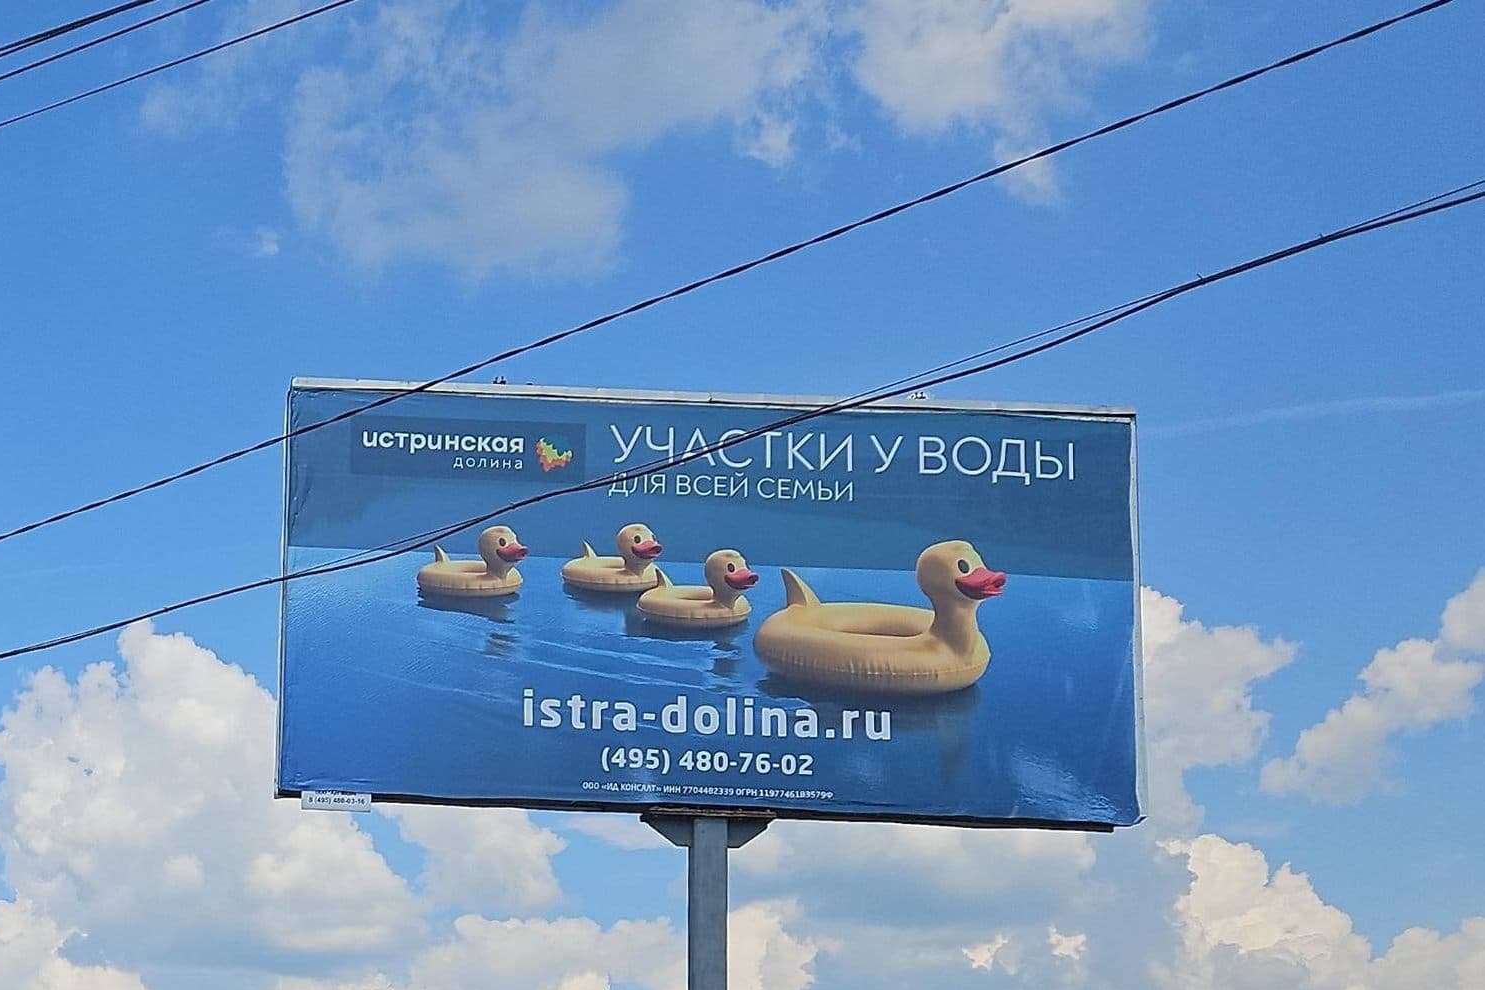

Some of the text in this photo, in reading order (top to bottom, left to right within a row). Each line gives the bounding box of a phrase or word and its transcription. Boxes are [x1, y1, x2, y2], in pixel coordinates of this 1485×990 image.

[362, 429, 525, 454] истринская
[609, 424, 1075, 486] УЧАСТКИ У ВОДЫ
[453, 456, 524, 471] долина
[608, 472, 855, 502] ДЛЯ ВСЕЙ СЕМЬИ
[522, 688, 892, 741] istra-dolina.ru
[600, 746, 815, 776] (495) 480-76-02
[582, 781, 600, 790] ООО
[663, 785, 681, 794] ИНН
[735, 787, 757, 797] ОГРН
